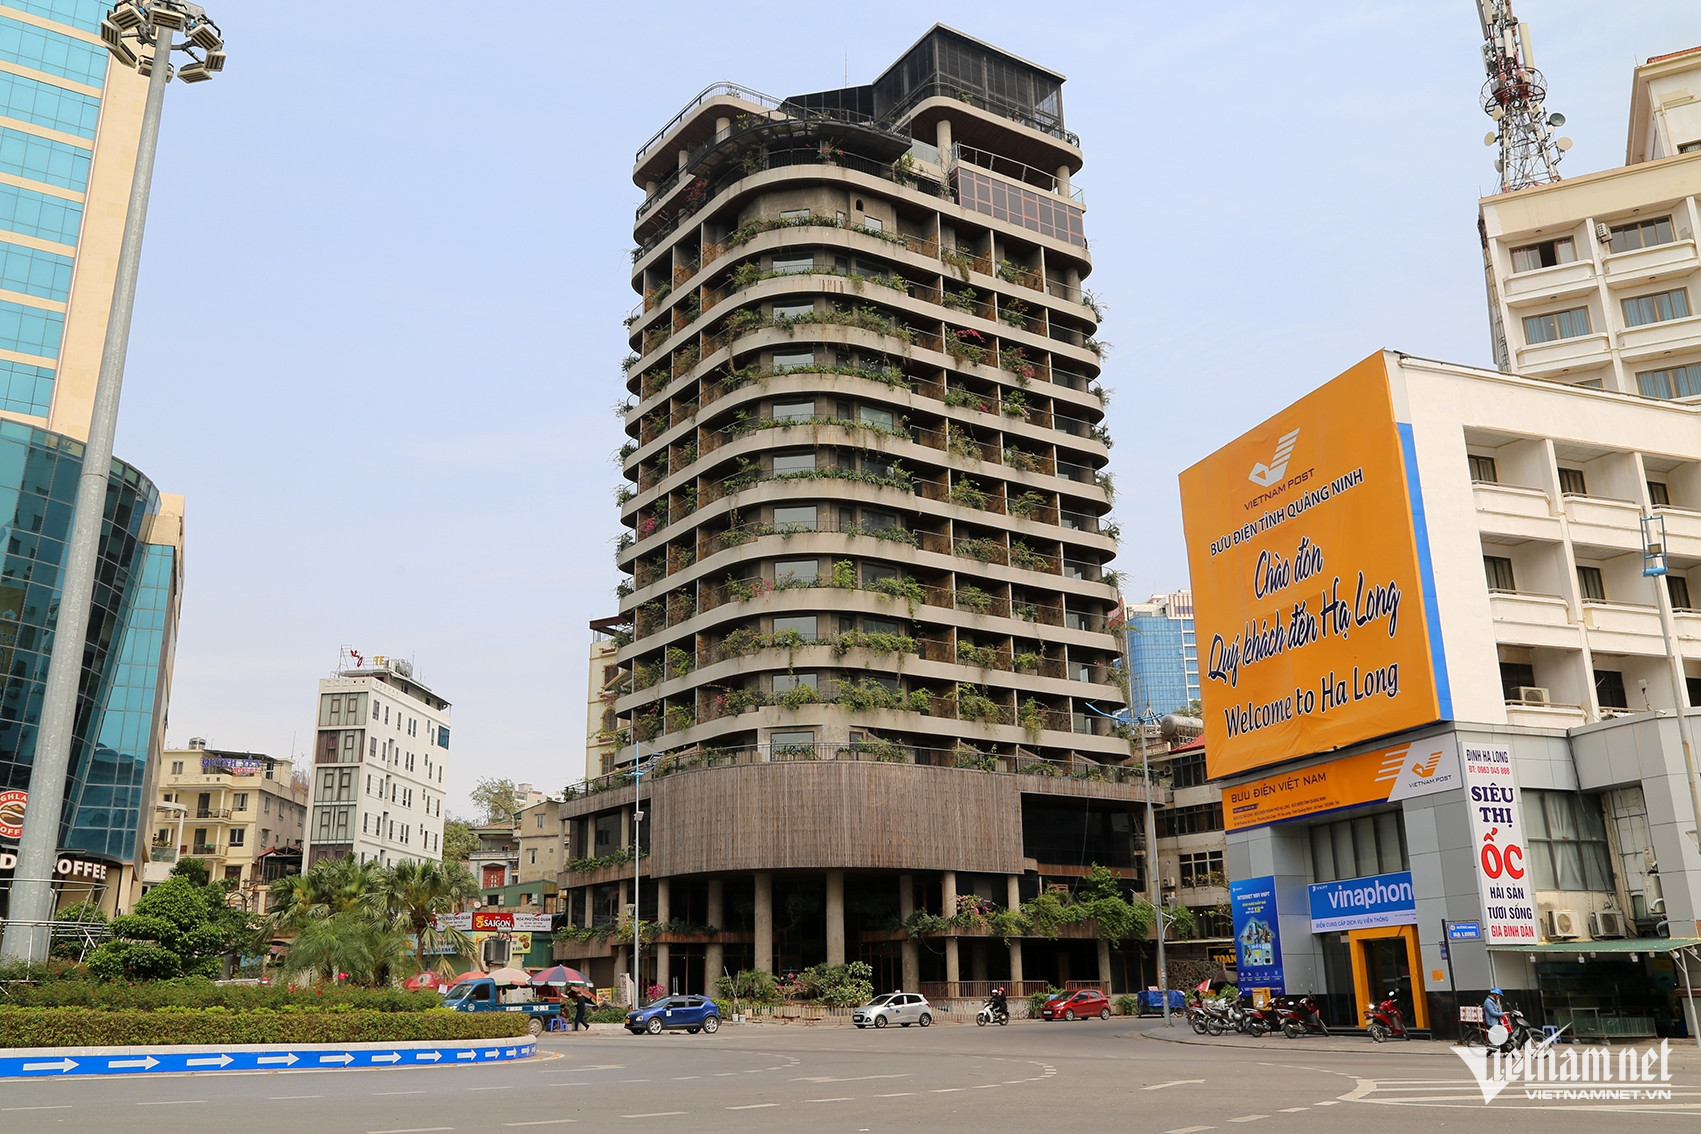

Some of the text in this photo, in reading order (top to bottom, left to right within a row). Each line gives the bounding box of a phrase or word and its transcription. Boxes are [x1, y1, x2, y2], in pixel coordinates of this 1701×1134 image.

[1244, 468, 1315, 510] VIETNAM POST
[1210, 467, 1364, 557] BƯU ĐIỆN TỈNH QUẢNG NINH
[1254, 536, 1324, 599] Chào đón
[1208, 570, 1401, 687] Quý khách đến Hạ Long
[1224, 662, 1400, 738] Welcome to Ha Long
[1482, 750, 1491, 765] HẠ
[1492, 750, 1508, 763] LONG
[1232, 772, 1326, 803] BƯU ĐIỆN VIỆT NAM
[1408, 779, 1435, 787] VIETNAM
[1471, 783, 1514, 803] SIÊU
[1479, 807, 1513, 828] THỊ
[1481, 827, 1524, 880] ỐC
[52, 858, 107, 880] OFFEE
[1328, 880, 1414, 909] vinaphon
[1490, 883, 1524, 899] HẢI SẢN
[1487, 903, 1532, 919] TƯƠI SỐNG
[484, 920, 510, 928] SAIGON
[1503, 923, 1519, 937] BÌNH
[1520, 923, 1534, 937] DÂN
